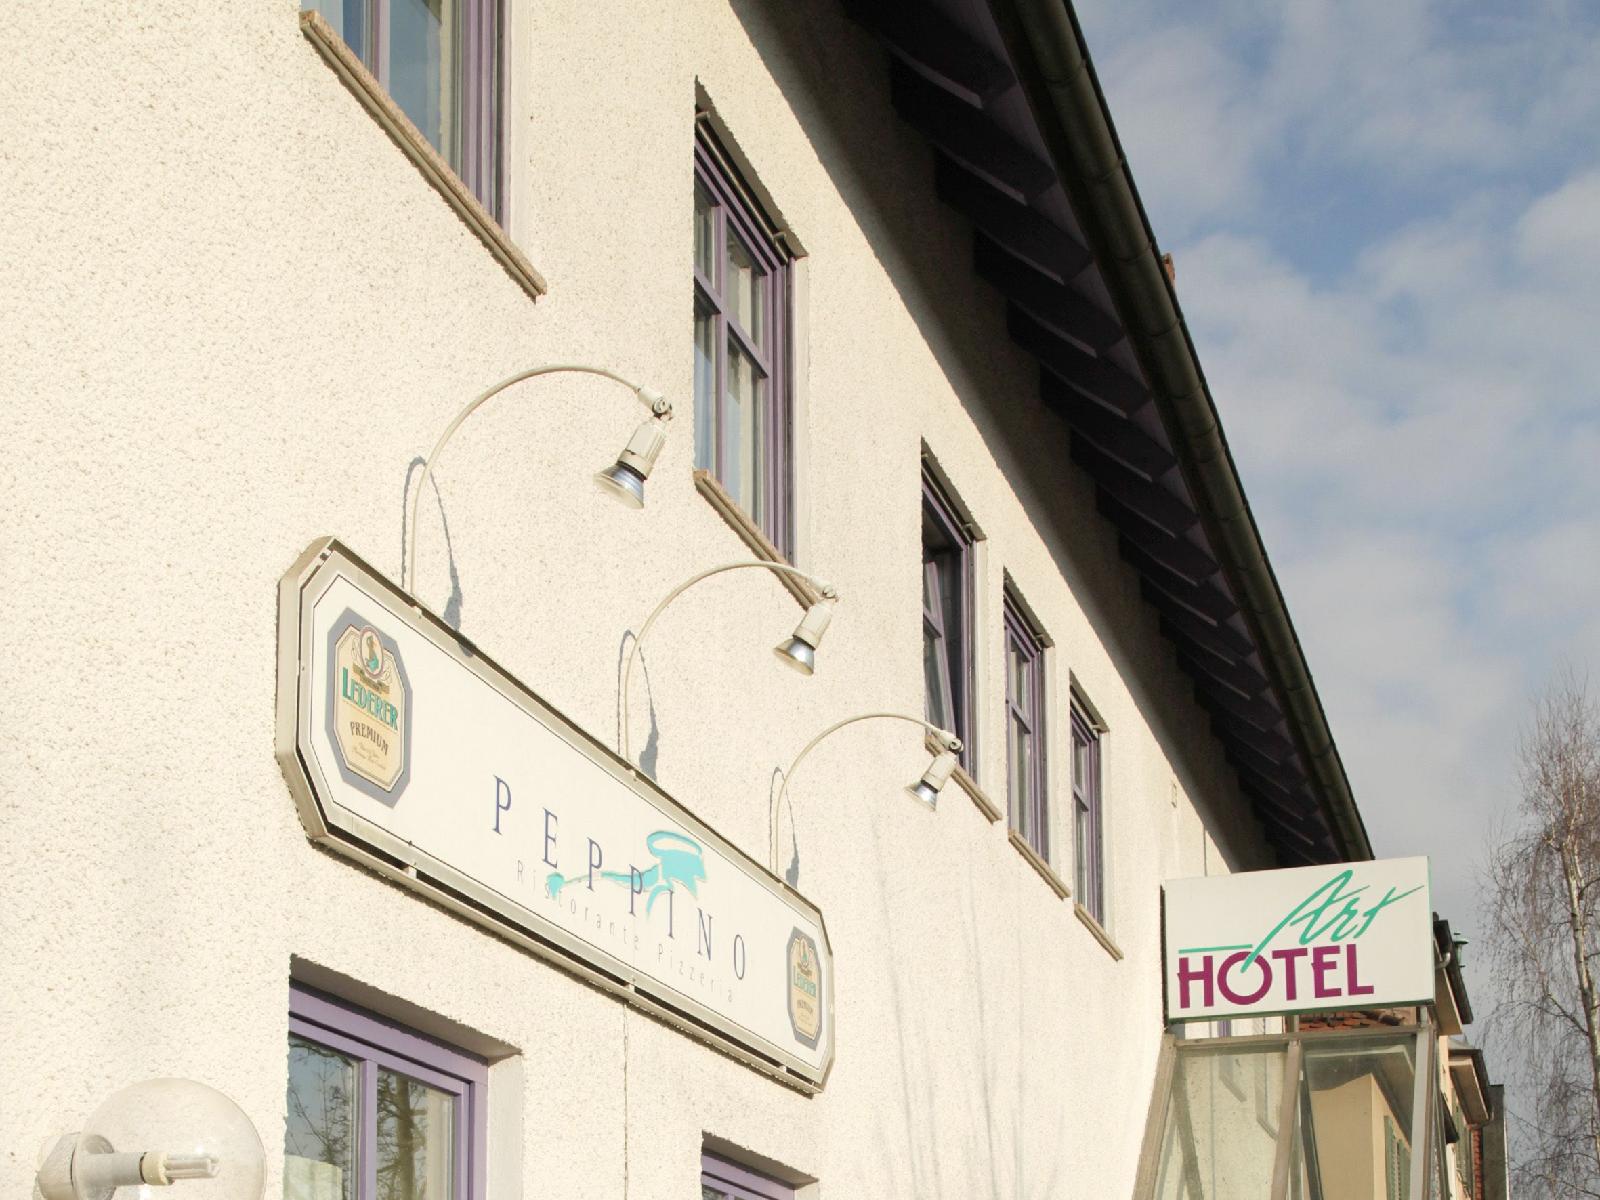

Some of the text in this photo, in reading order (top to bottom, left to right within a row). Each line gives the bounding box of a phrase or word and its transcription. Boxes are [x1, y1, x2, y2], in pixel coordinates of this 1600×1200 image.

[342, 667, 398, 731] LEDERER
[350, 721, 389, 755] PREMIUM
[492, 774, 746, 981] PEPPINO
[517, 859, 640, 951] Ristorante
[1239, 869, 1425, 973] Art
[1177, 943, 1374, 1009] HOTEL
